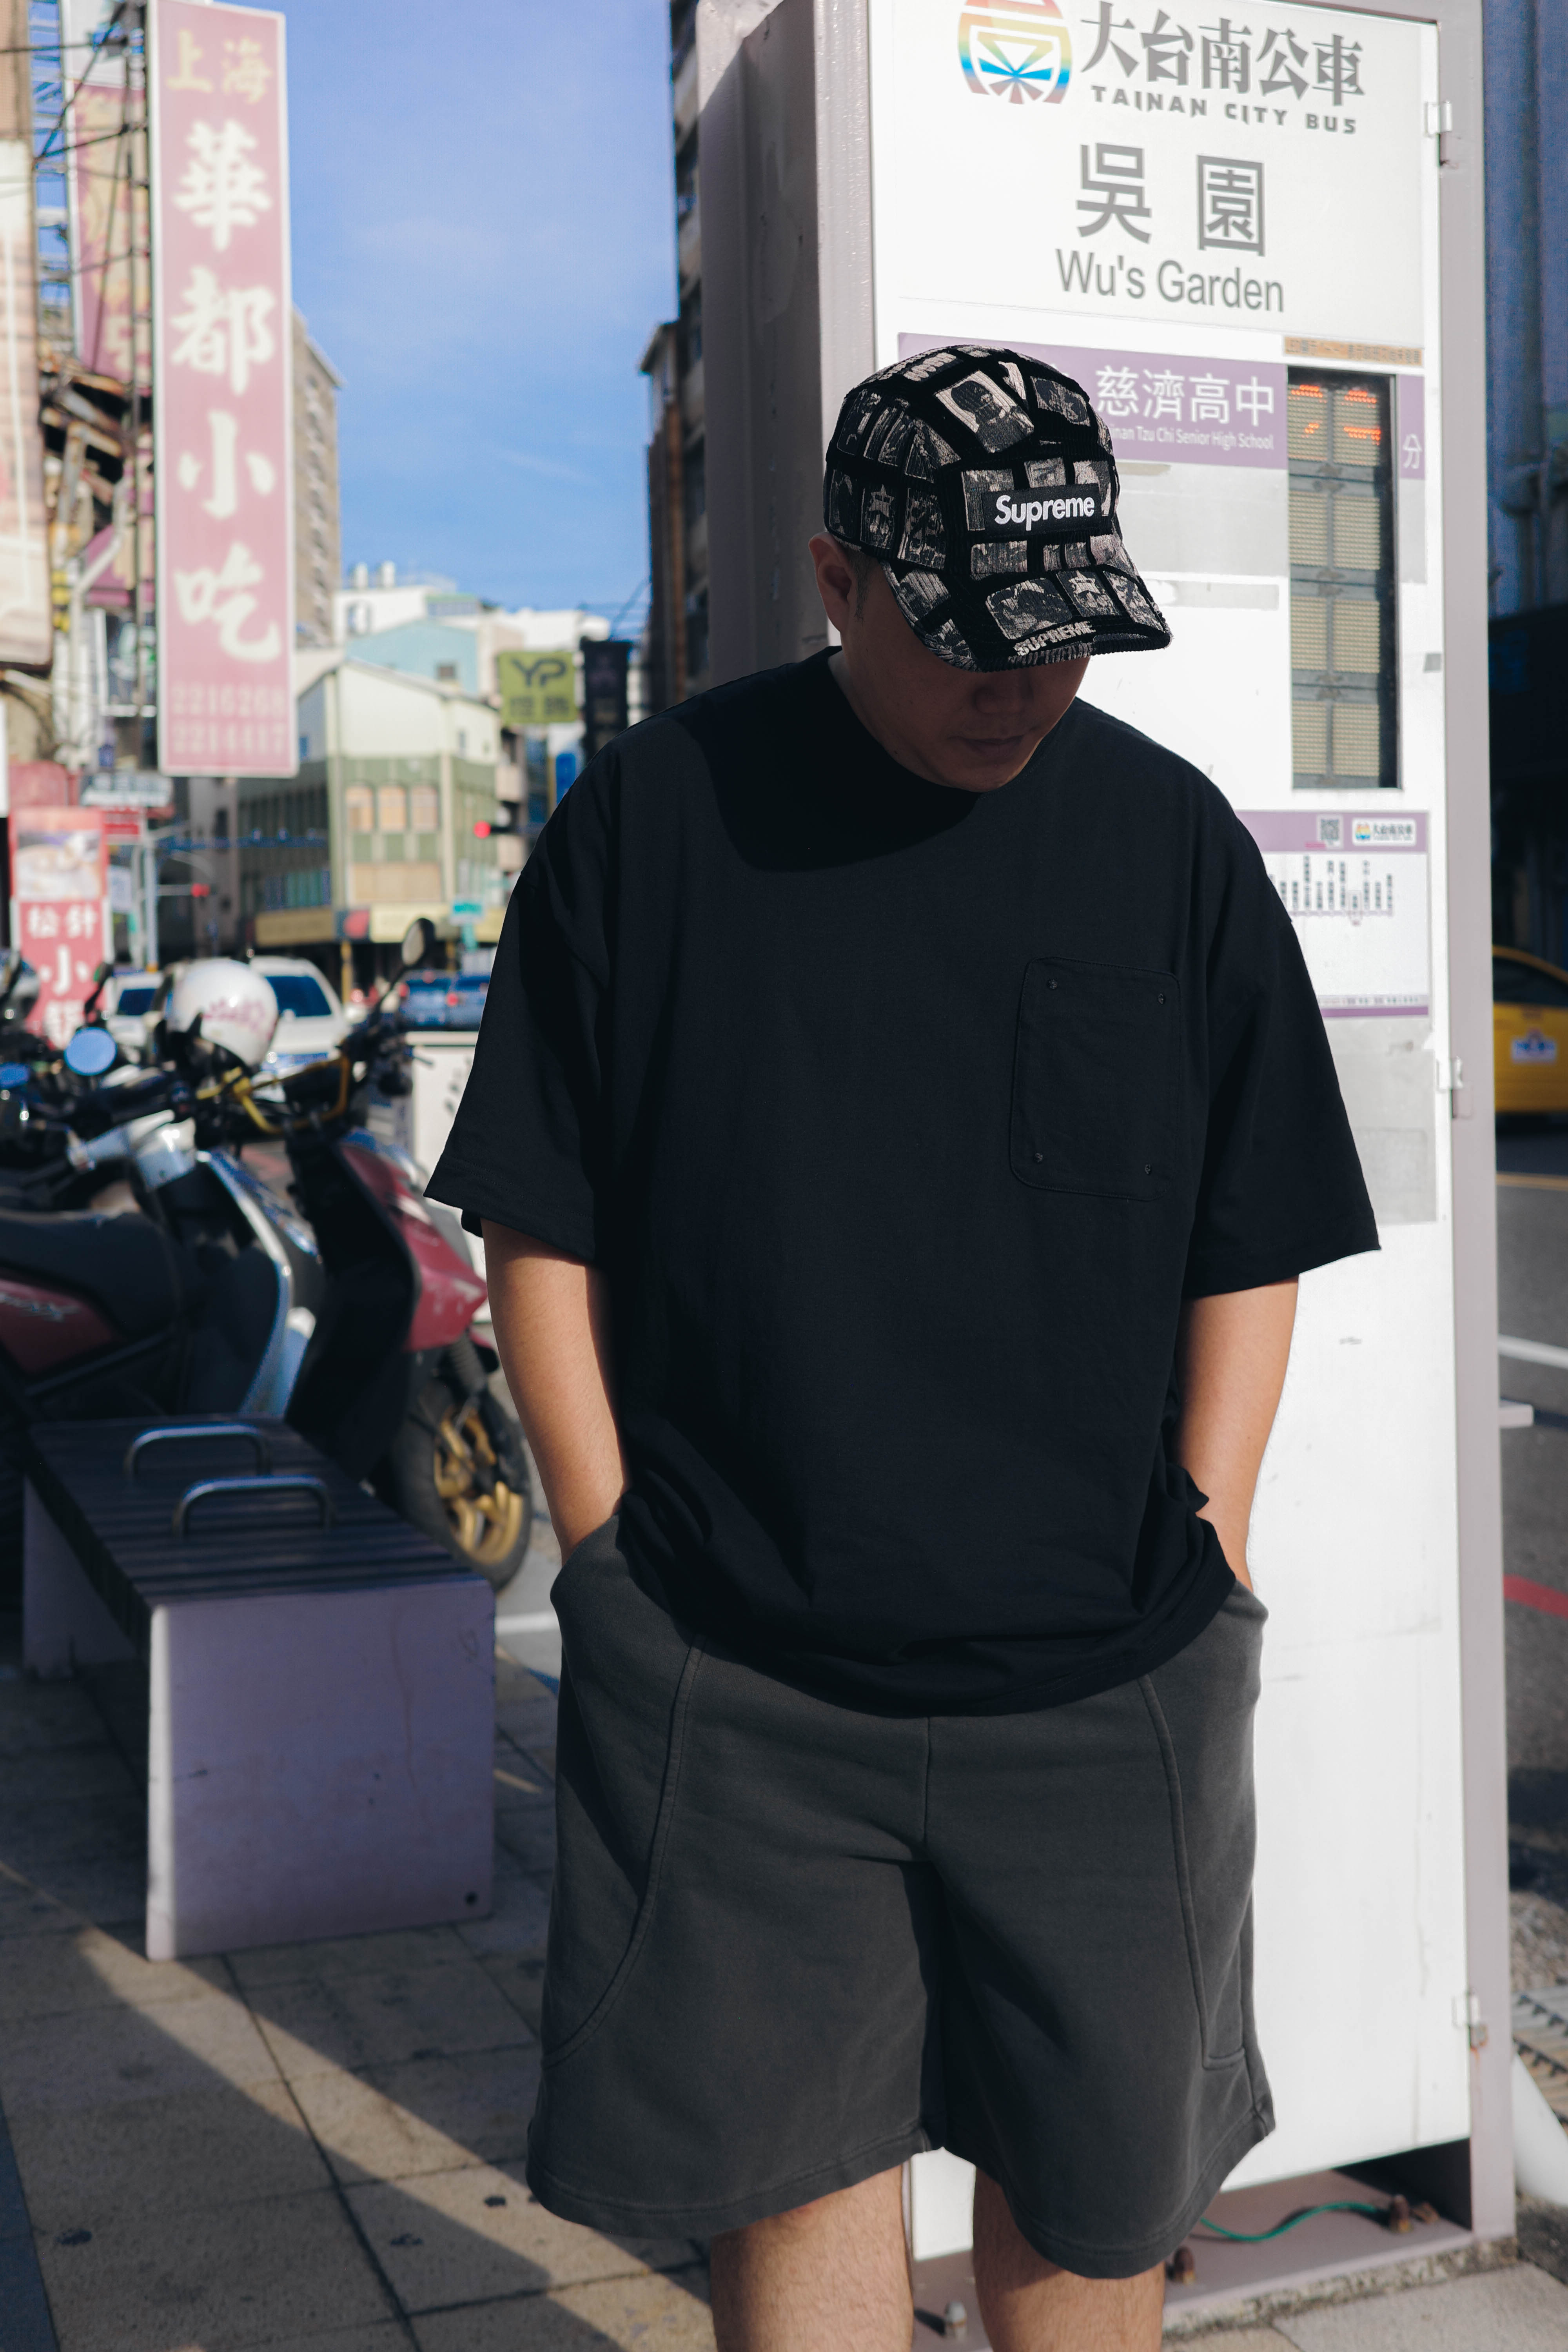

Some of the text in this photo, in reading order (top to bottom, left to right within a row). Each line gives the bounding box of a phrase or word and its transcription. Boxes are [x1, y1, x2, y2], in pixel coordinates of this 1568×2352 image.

[165, 28, 274, 104] 上海
[1080, 1, 1365, 106] 大台南公車
[1091, 85, 1356, 134] TAINAN CITY BUS
[1076, 143, 1266, 257] 吳園
[1056, 249, 1285, 312] Wu's Garden
[169, 118, 281, 664] 華都小吃
[1095, 365, 1275, 427] 慈濟高中
[1109, 423, 1135, 440] inan
[1156, 426, 1174, 443] Chi
[1176, 428, 1210, 446] Senior
[1212, 430, 1237, 450] High
[1238, 433, 1274, 450] School
[1402, 434, 1423, 469] 分
[995, 495, 1095, 531] Supreme
[511, 656, 568, 688] YP
